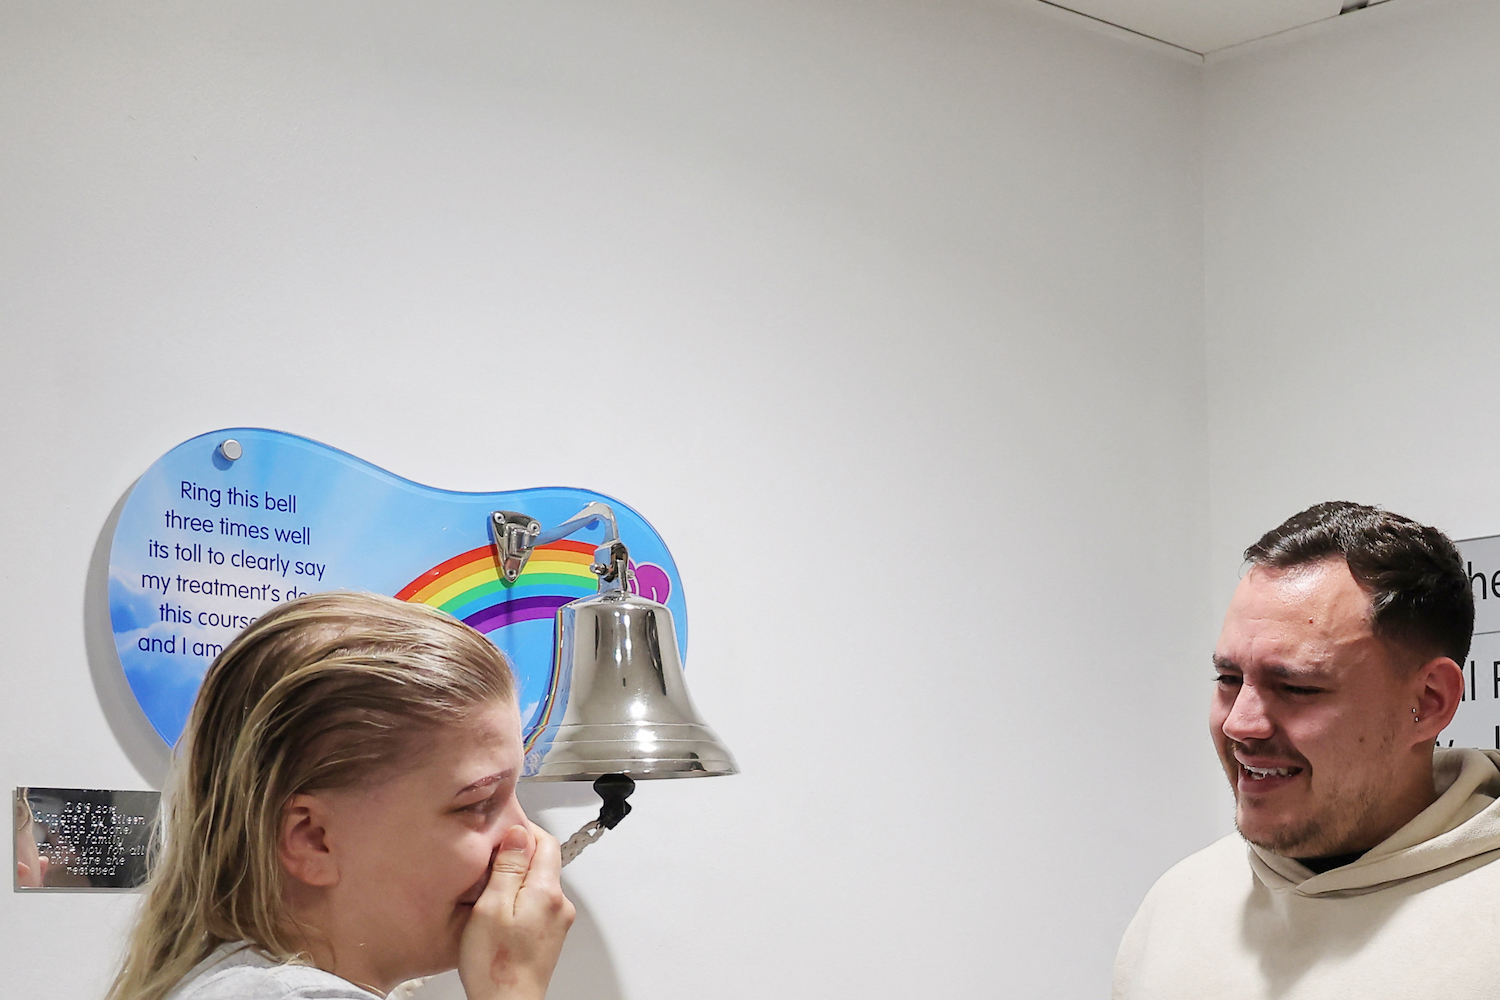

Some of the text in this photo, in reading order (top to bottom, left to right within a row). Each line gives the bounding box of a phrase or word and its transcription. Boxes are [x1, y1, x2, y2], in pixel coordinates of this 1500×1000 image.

[181, 481, 296, 513] Ring this bell
[165, 509, 310, 545] three times well
[149, 539, 326, 581] its toll to clearly say
[142, 574, 171, 595] my
[176, 575, 280, 602] treatment's
[159, 603, 192, 624] this
[138, 635, 223, 657] and I am
[81, 846, 103, 857] you
[106, 844, 126, 856] for
[129, 845, 146, 856] all
[85, 834, 124, 847] family
